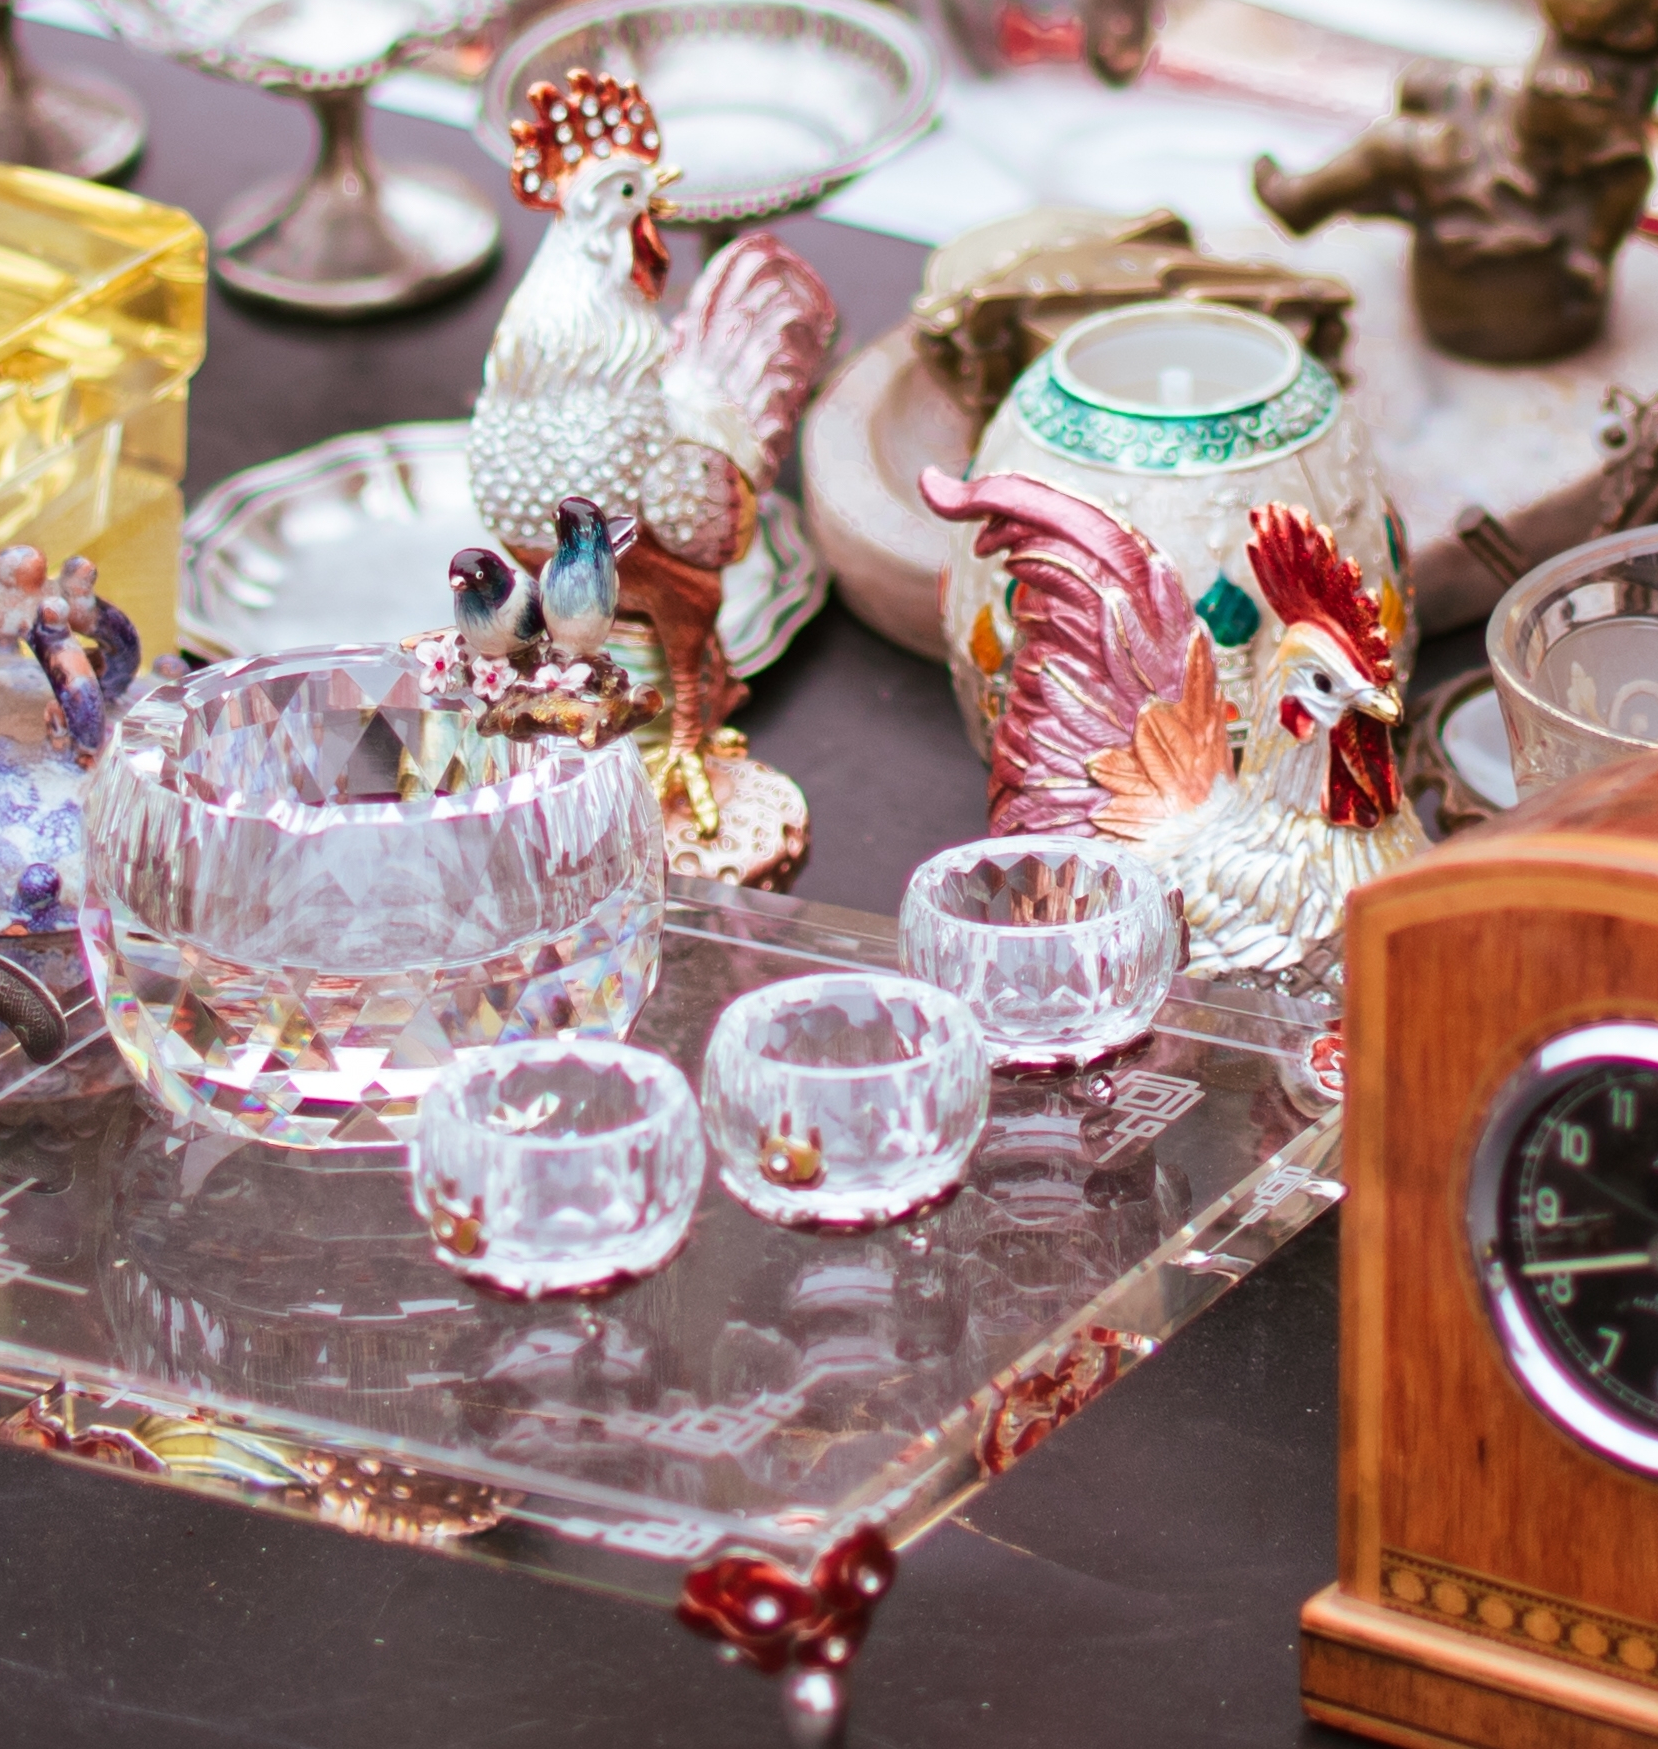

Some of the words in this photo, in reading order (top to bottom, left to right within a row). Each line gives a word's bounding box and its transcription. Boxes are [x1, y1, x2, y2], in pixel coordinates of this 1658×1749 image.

[1610, 1087, 1634, 1129] 11
[1560, 1122, 1590, 1166] 10
[1536, 1187, 1559, 1226] 9
[1551, 1272, 1574, 1304] 8
[1598, 1327, 1621, 1367] 7
